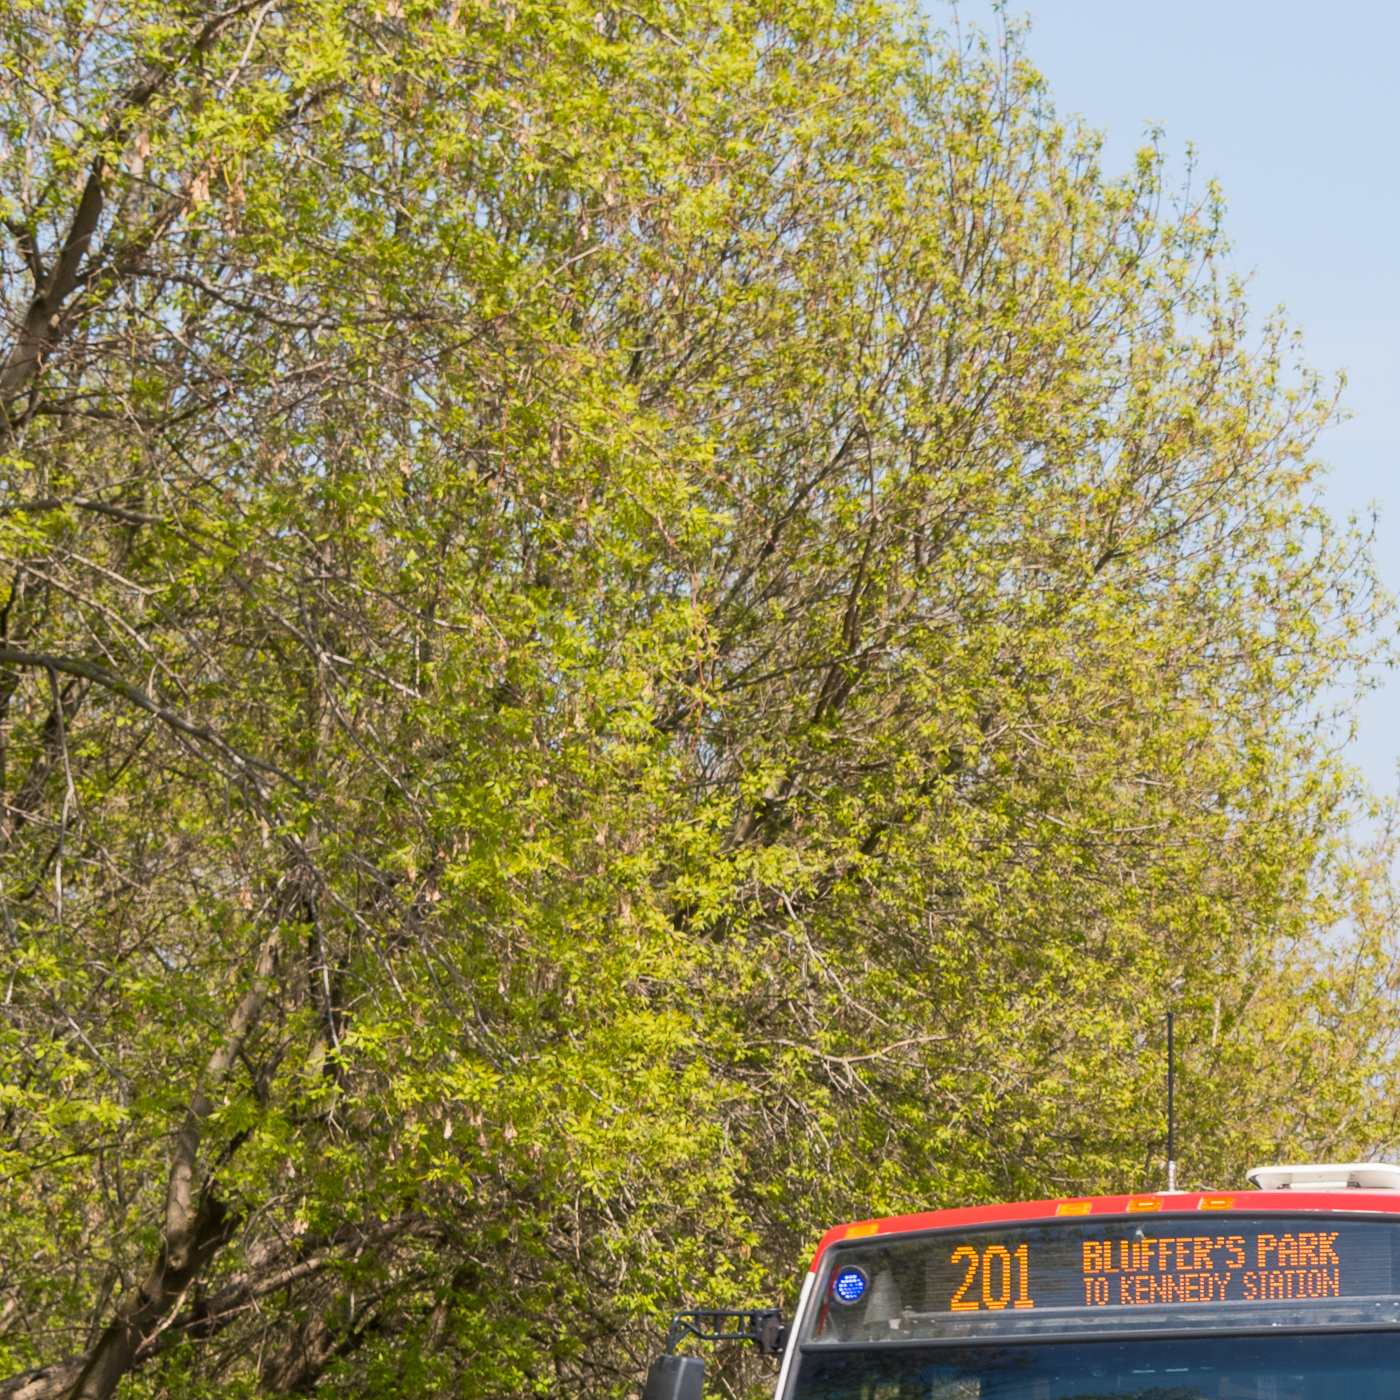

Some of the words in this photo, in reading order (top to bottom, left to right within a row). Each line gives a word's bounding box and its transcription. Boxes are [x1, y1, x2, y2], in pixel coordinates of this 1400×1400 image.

[1083, 1235, 1246, 1274] BLUFFER'S
[1257, 1231, 1340, 1268] PARK
[950, 1243, 1034, 1312] 201
[1083, 1276, 1110, 1306] TO
[1120, 1271, 1231, 1305] KENNEDY
[1243, 1267, 1340, 1301] STATION
